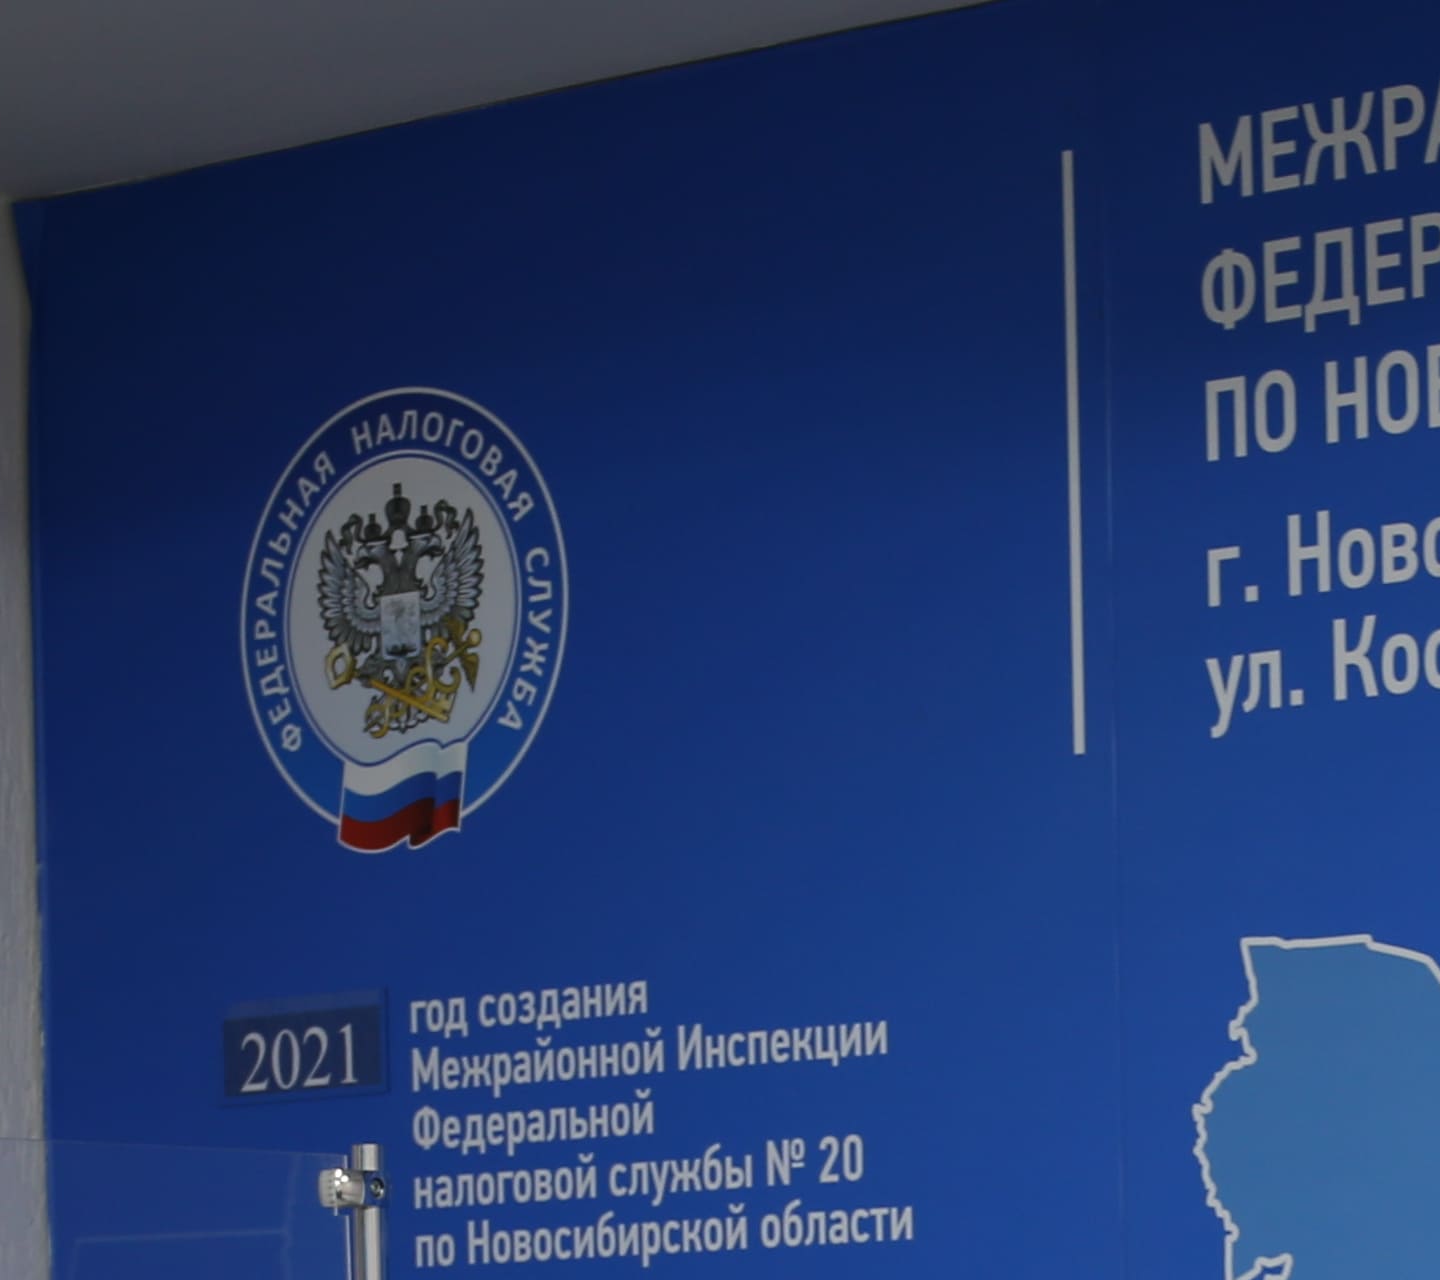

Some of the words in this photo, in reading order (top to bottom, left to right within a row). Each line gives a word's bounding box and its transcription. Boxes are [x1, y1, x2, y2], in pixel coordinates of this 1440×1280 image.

[1205, 369, 1297, 461] ПО
[253, 451, 336, 752] ФЕДЕРАЛЬНАЯ
[350, 409, 534, 523] НАЛОГОВАЯ
[497, 546, 553, 731] СЛУЖБА
[1206, 545, 1259, 607] г.
[1205, 649, 1305, 739] ул.
[409, 996, 469, 1037] год
[478, 980, 648, 1030] создания
[240, 1023, 359, 1093] 2021
[411, 1027, 665, 1098] Межрайонной
[677, 1020, 888, 1071] Инспекции
[412, 1088, 655, 1156] Федеральной
[413, 1153, 597, 1209] налоговой
[608, 1142, 753, 1206] службы
[766, 1137, 806, 1187] №
[818, 1133, 865, 1184] 20
[415, 1232, 456, 1268] по
[467, 1203, 748, 1268] Новосибирской
[760, 1198, 914, 1249] области
